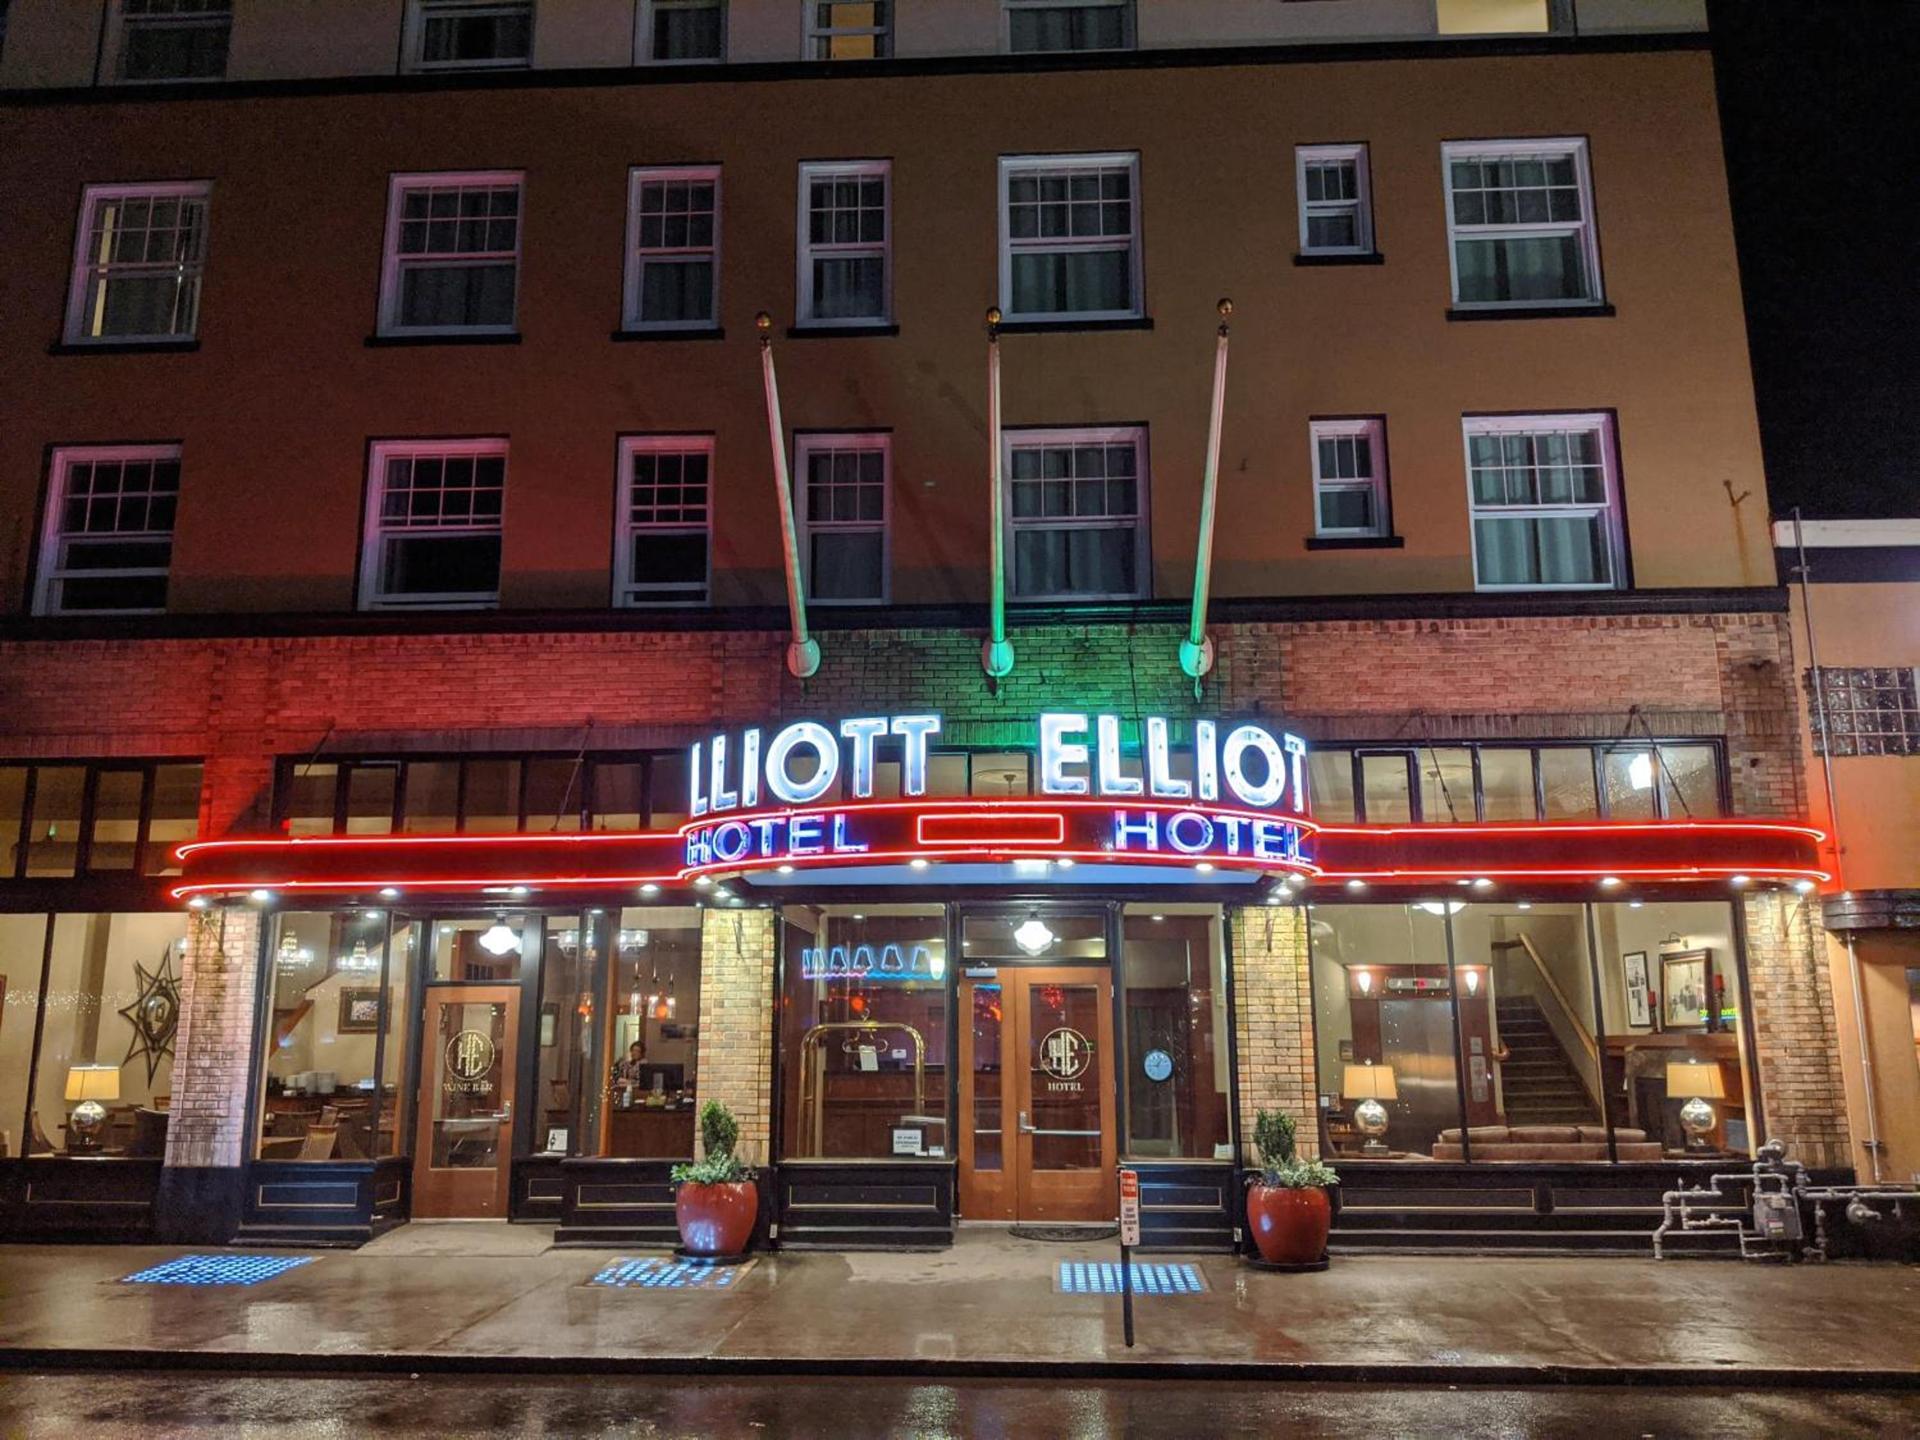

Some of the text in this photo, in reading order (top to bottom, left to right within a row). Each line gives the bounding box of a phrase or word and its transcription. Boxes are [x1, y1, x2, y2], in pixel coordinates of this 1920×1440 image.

[690, 714, 941, 817] LLIOTT
[1040, 713, 1308, 814] ELLIOT
[686, 814, 869, 866] HOTEL
[1114, 810, 1312, 863] HOTEL
[1047, 1081, 1085, 1092] HOTEL
